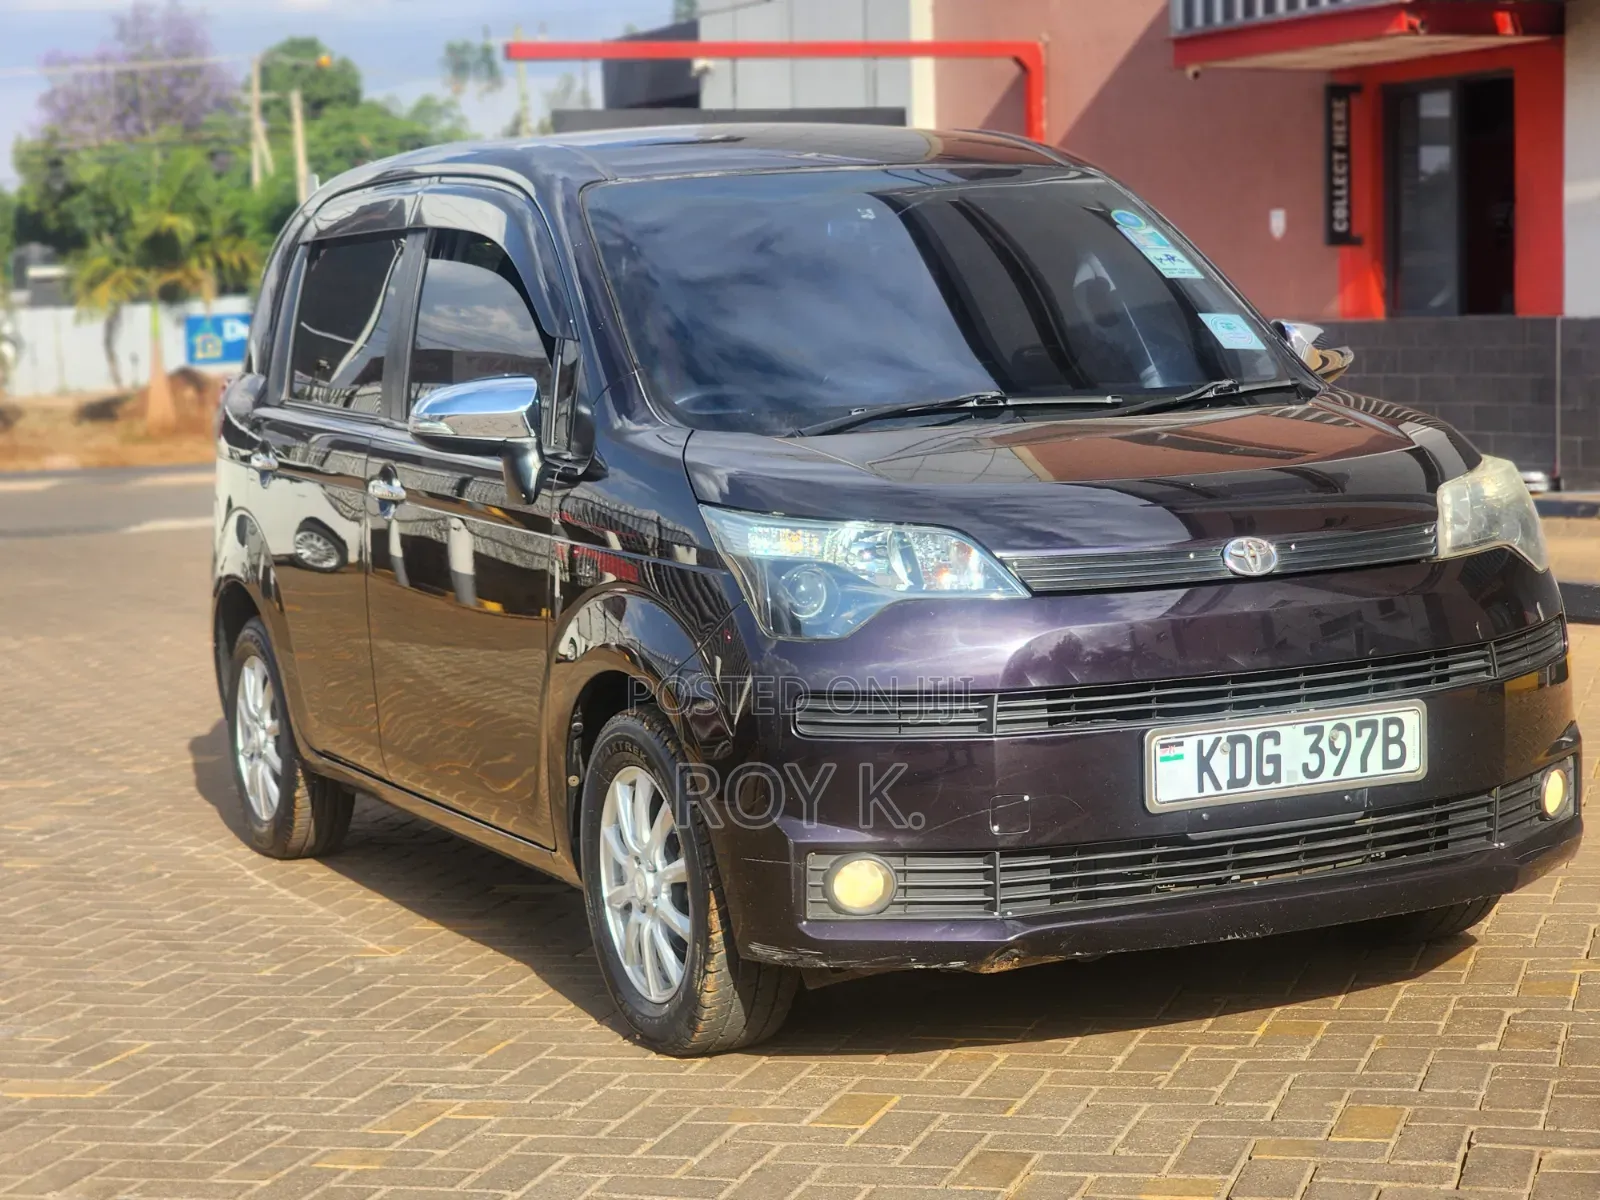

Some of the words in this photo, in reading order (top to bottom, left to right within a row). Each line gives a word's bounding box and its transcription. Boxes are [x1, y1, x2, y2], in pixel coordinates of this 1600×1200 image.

[1332, 97, 1348, 147] HERE
[1332, 151, 1349, 233] COLLECT
[1197, 731, 1282, 793] KDG
[1301, 717, 1407, 780] 397B
